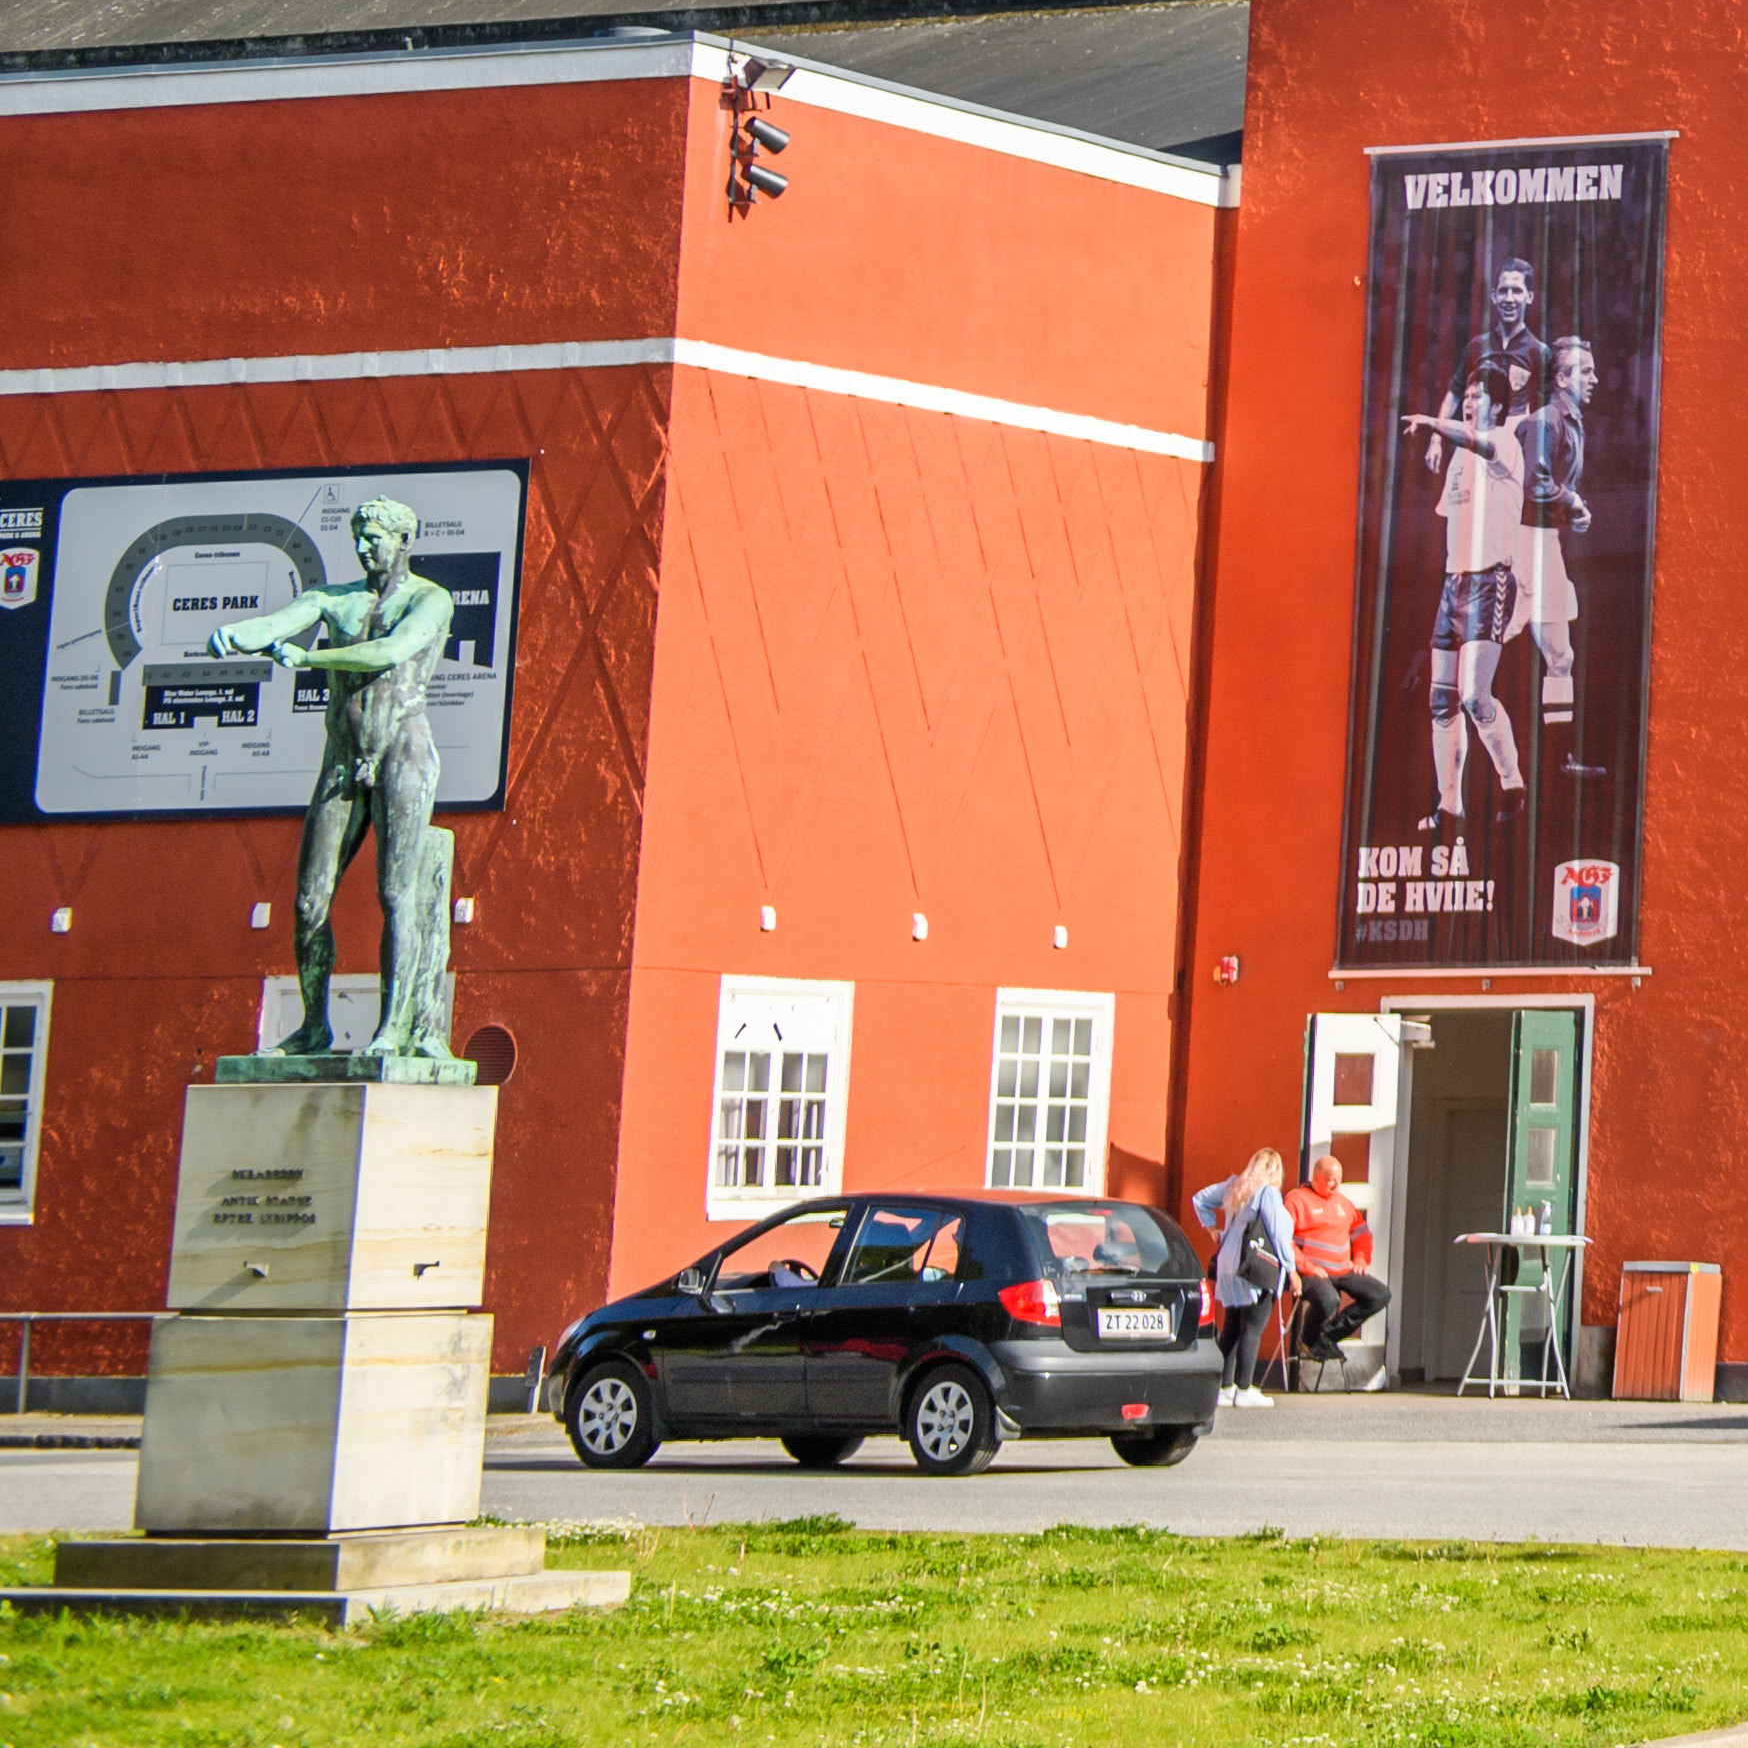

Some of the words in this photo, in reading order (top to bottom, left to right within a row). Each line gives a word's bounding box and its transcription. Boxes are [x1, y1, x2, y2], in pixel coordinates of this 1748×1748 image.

[1404, 164, 1624, 210] VELKOMMEN
[0, 512, 43, 528] CERES
[173, 597, 218, 612] CERES
[222, 595, 259, 610] PARK
[452, 590, 490, 605] RENA
[297, 689, 319, 702] HAL
[153, 712, 176, 725] HAL
[222, 711, 244, 724] HAL
[247, 710, 255, 722] 2
[1358, 846, 1423, 878] KOM
[1431, 836, 1470, 877] SÅ
[1357, 882, 1396, 913] DE
[1355, 919, 1429, 942] #KSDH
[1106, 1315, 1121, 1330] ZT
[1125, 1315, 1139, 1329] 22
[1142, 1315, 1164, 1330] 028
